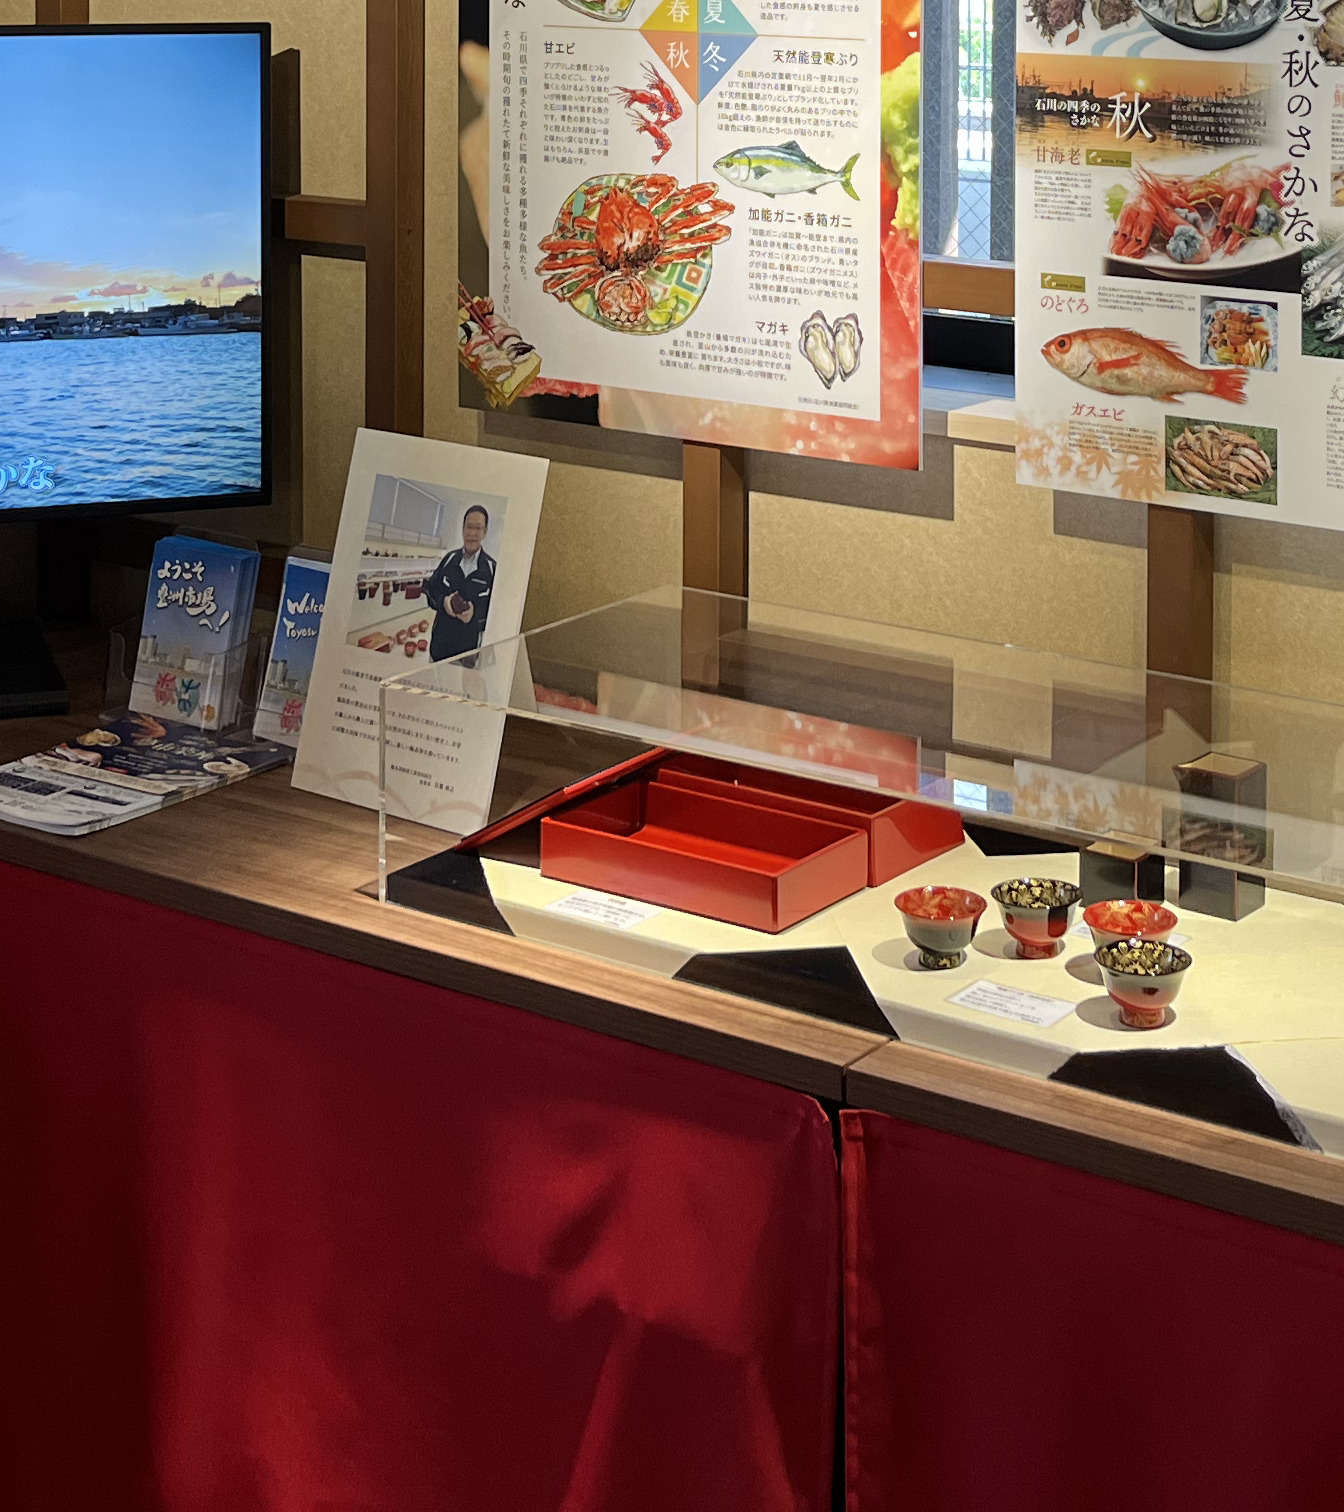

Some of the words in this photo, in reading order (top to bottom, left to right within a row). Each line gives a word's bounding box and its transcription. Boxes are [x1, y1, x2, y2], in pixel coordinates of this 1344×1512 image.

[544, 40, 576, 55] 甘エビ
[666, 41, 691, 70] 秋
[702, 42, 727, 73] 冬
[772, 49, 859, 67] 天然能登寒ぶり
[1034, 97, 1101, 113] 石川の四季の
[1069, 114, 1101, 128] さかな
[1105, 91, 1156, 143] 秋
[1033, 145, 1082, 166] 甘海老
[748, 207, 853, 228] 加能ガニ・香箱ガニ
[1040, 294, 1090, 315] のどぐろ
[755, 320, 790, 336] マガキ
[1071, 402, 1126, 422] ガスエビ
[157, 559, 205, 582] ようこそ
